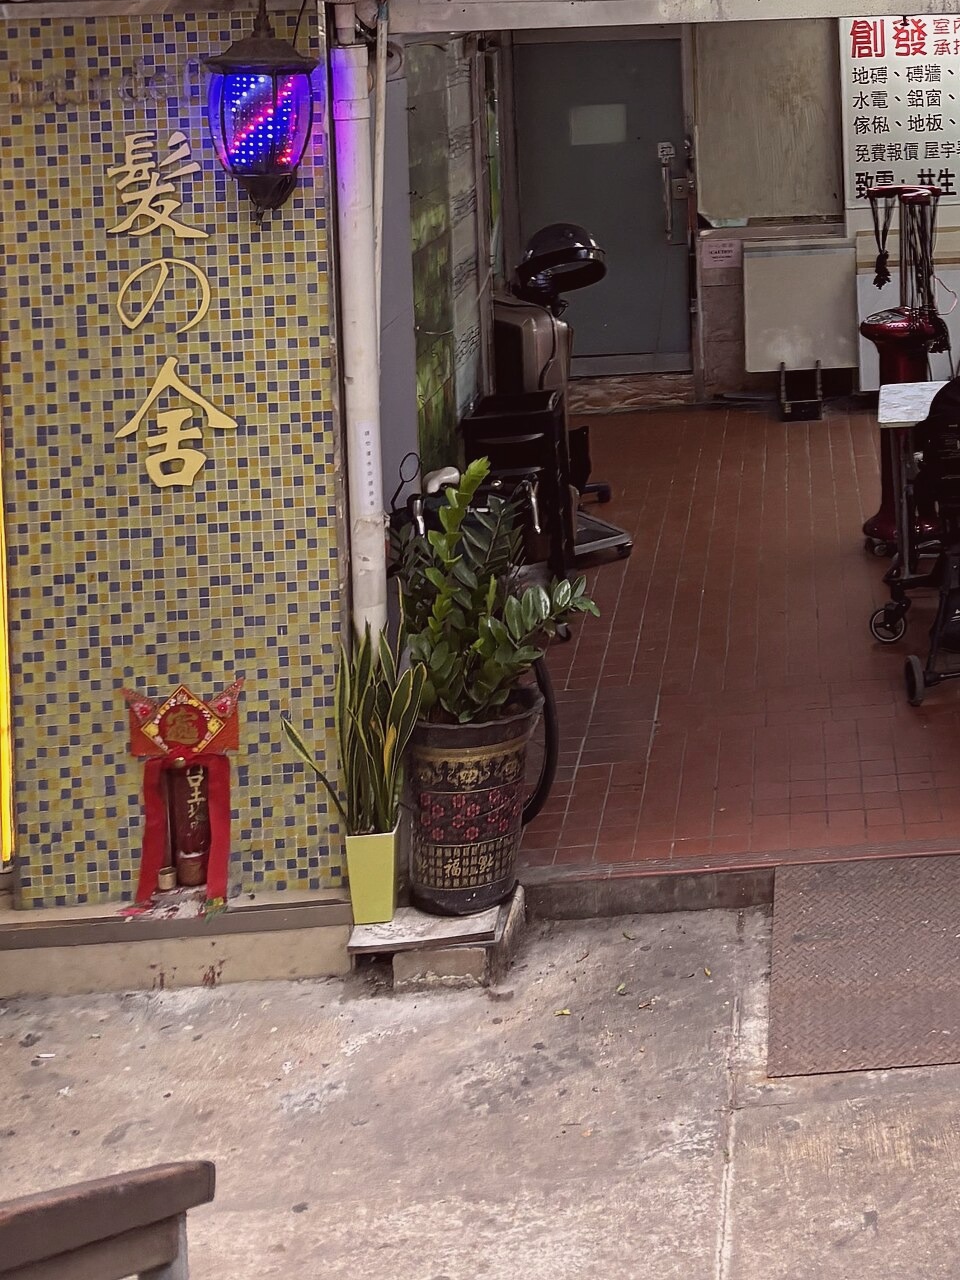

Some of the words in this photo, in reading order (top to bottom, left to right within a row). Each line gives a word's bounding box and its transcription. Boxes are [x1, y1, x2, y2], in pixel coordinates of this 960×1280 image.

[849, 18, 928, 59] 創發
[855, 142, 919, 163] 免費報價
